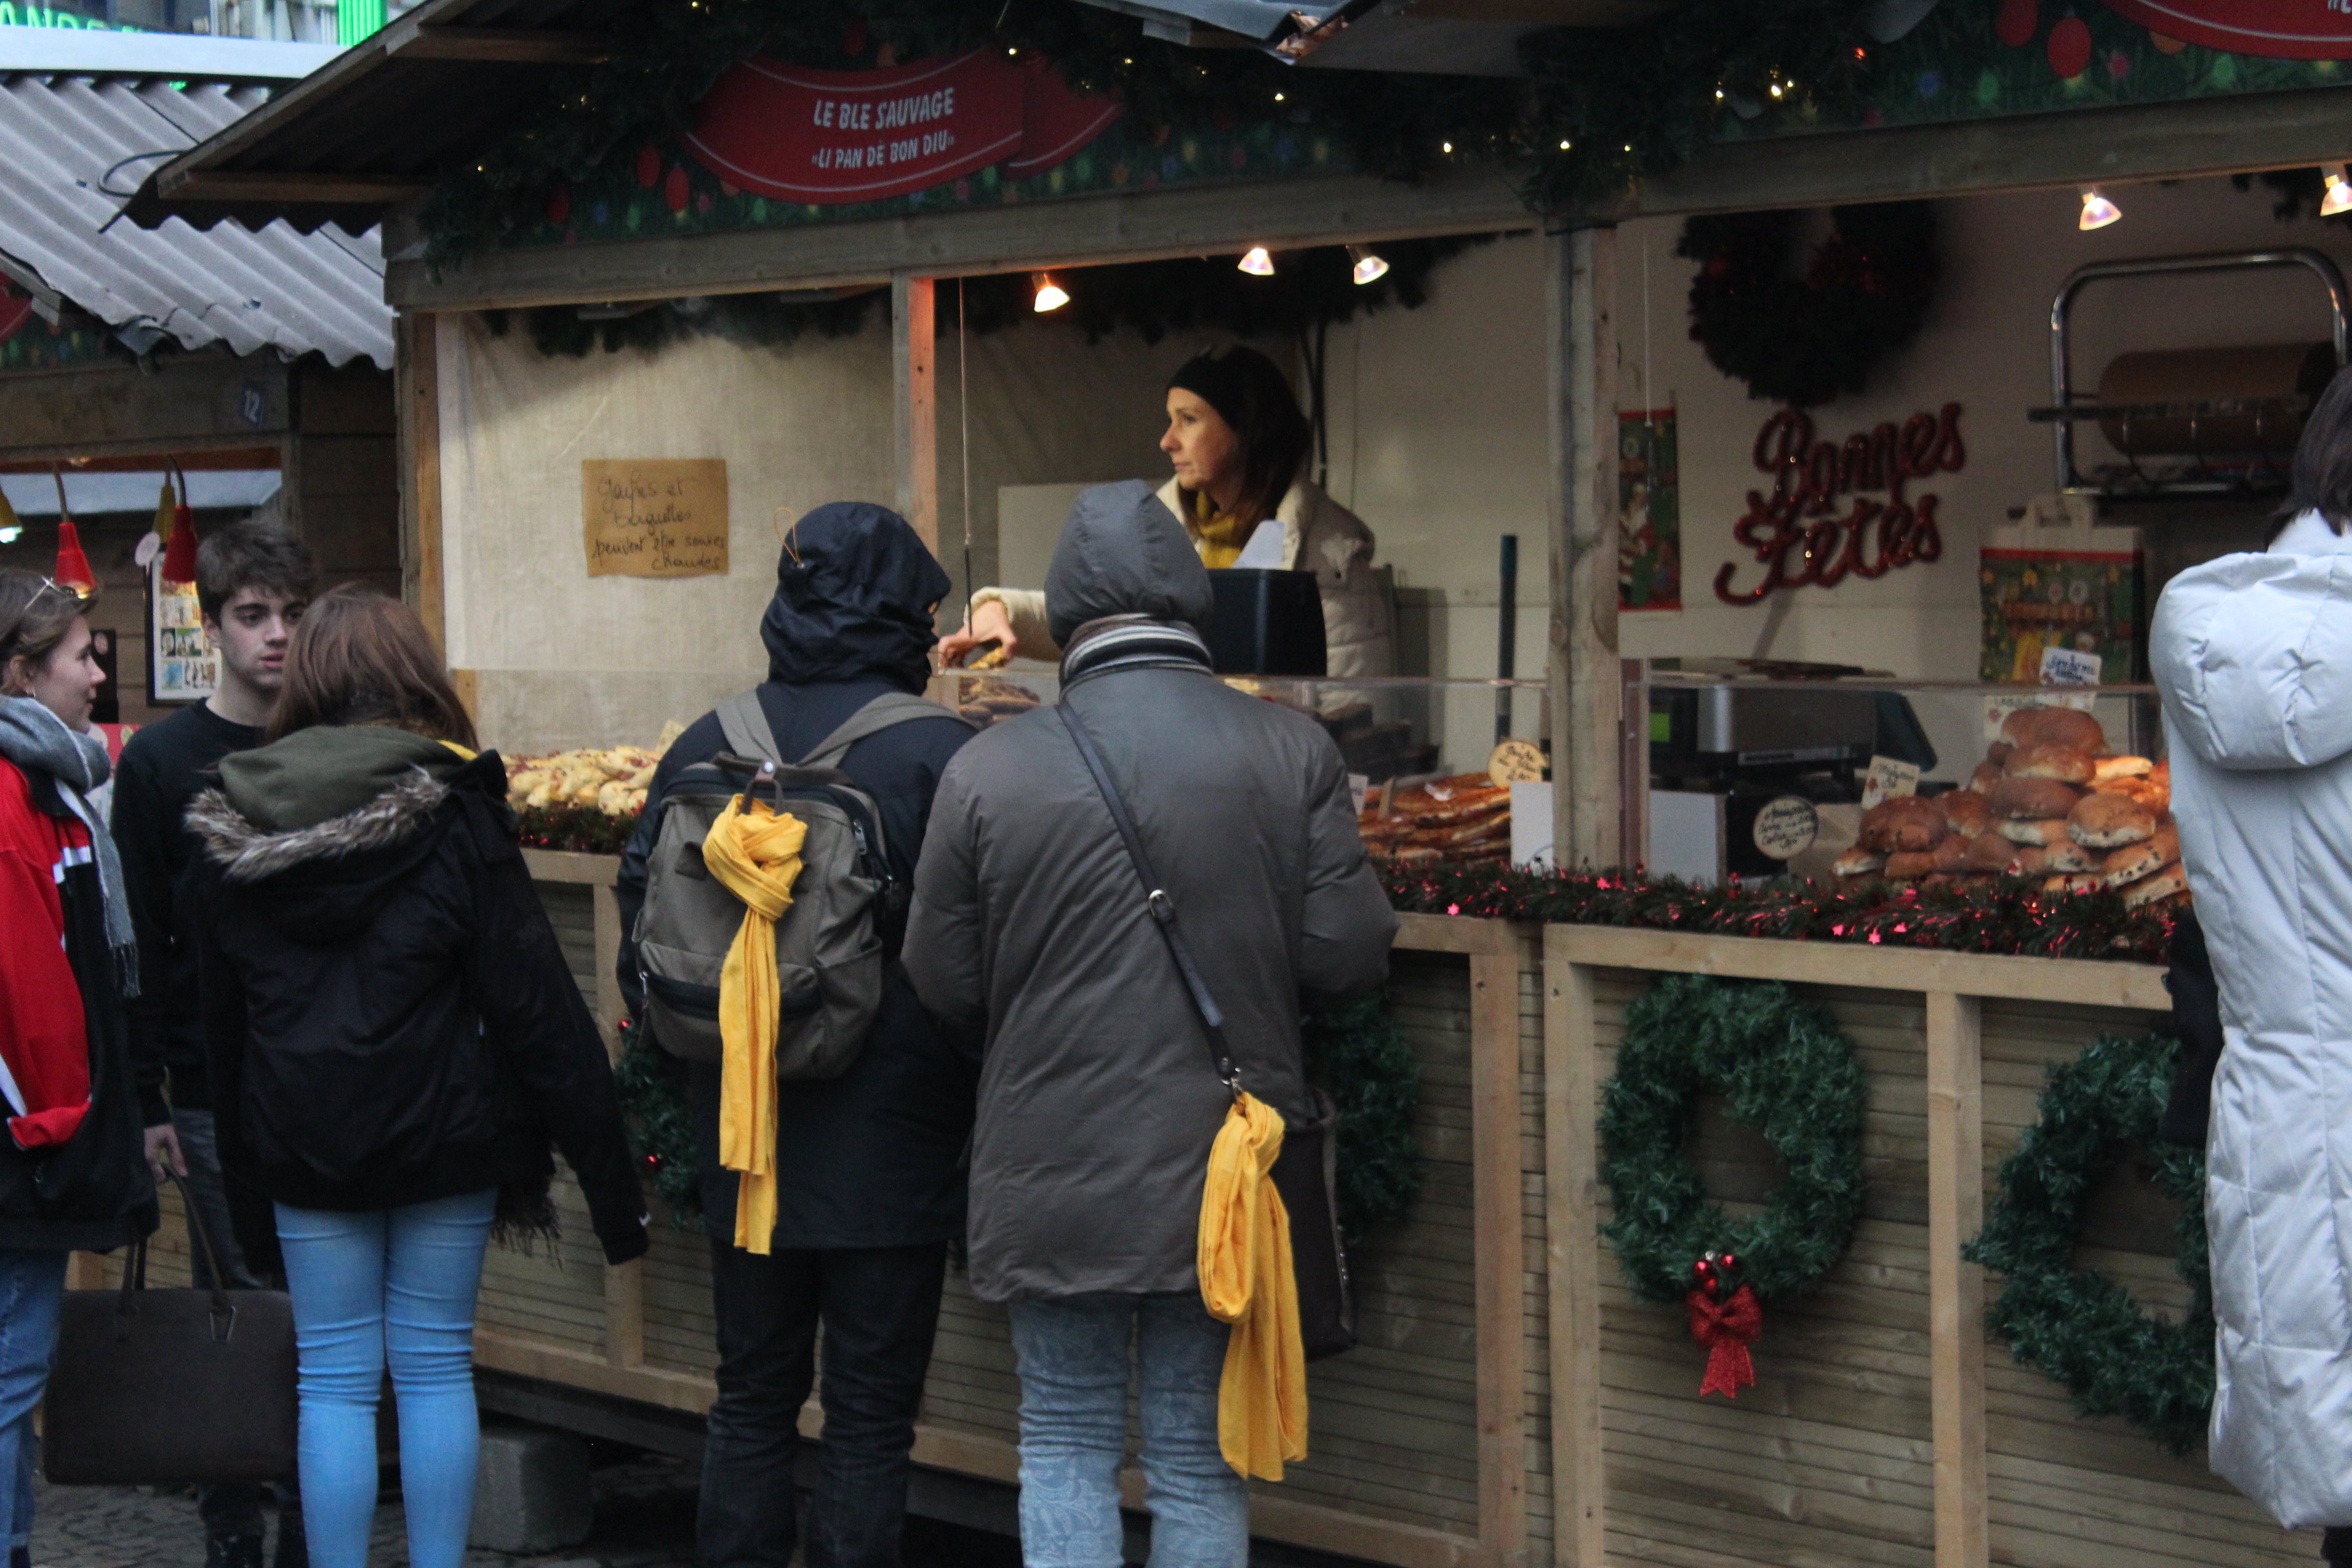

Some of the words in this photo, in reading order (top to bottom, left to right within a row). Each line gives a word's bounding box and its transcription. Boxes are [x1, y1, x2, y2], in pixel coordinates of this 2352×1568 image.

[813, 99, 834, 127] LE
[838, 102, 871, 130] BLE
[875, 87, 955, 130] SAUVAGE
[834, 147, 863, 169] PAN
[890, 137, 919, 163] BON
[244, 389, 260, 422] 12
[1749, 401, 1965, 517] Bonnes
[592, 538, 646, 567] peuvent
[652, 551, 719, 570] chaudes
